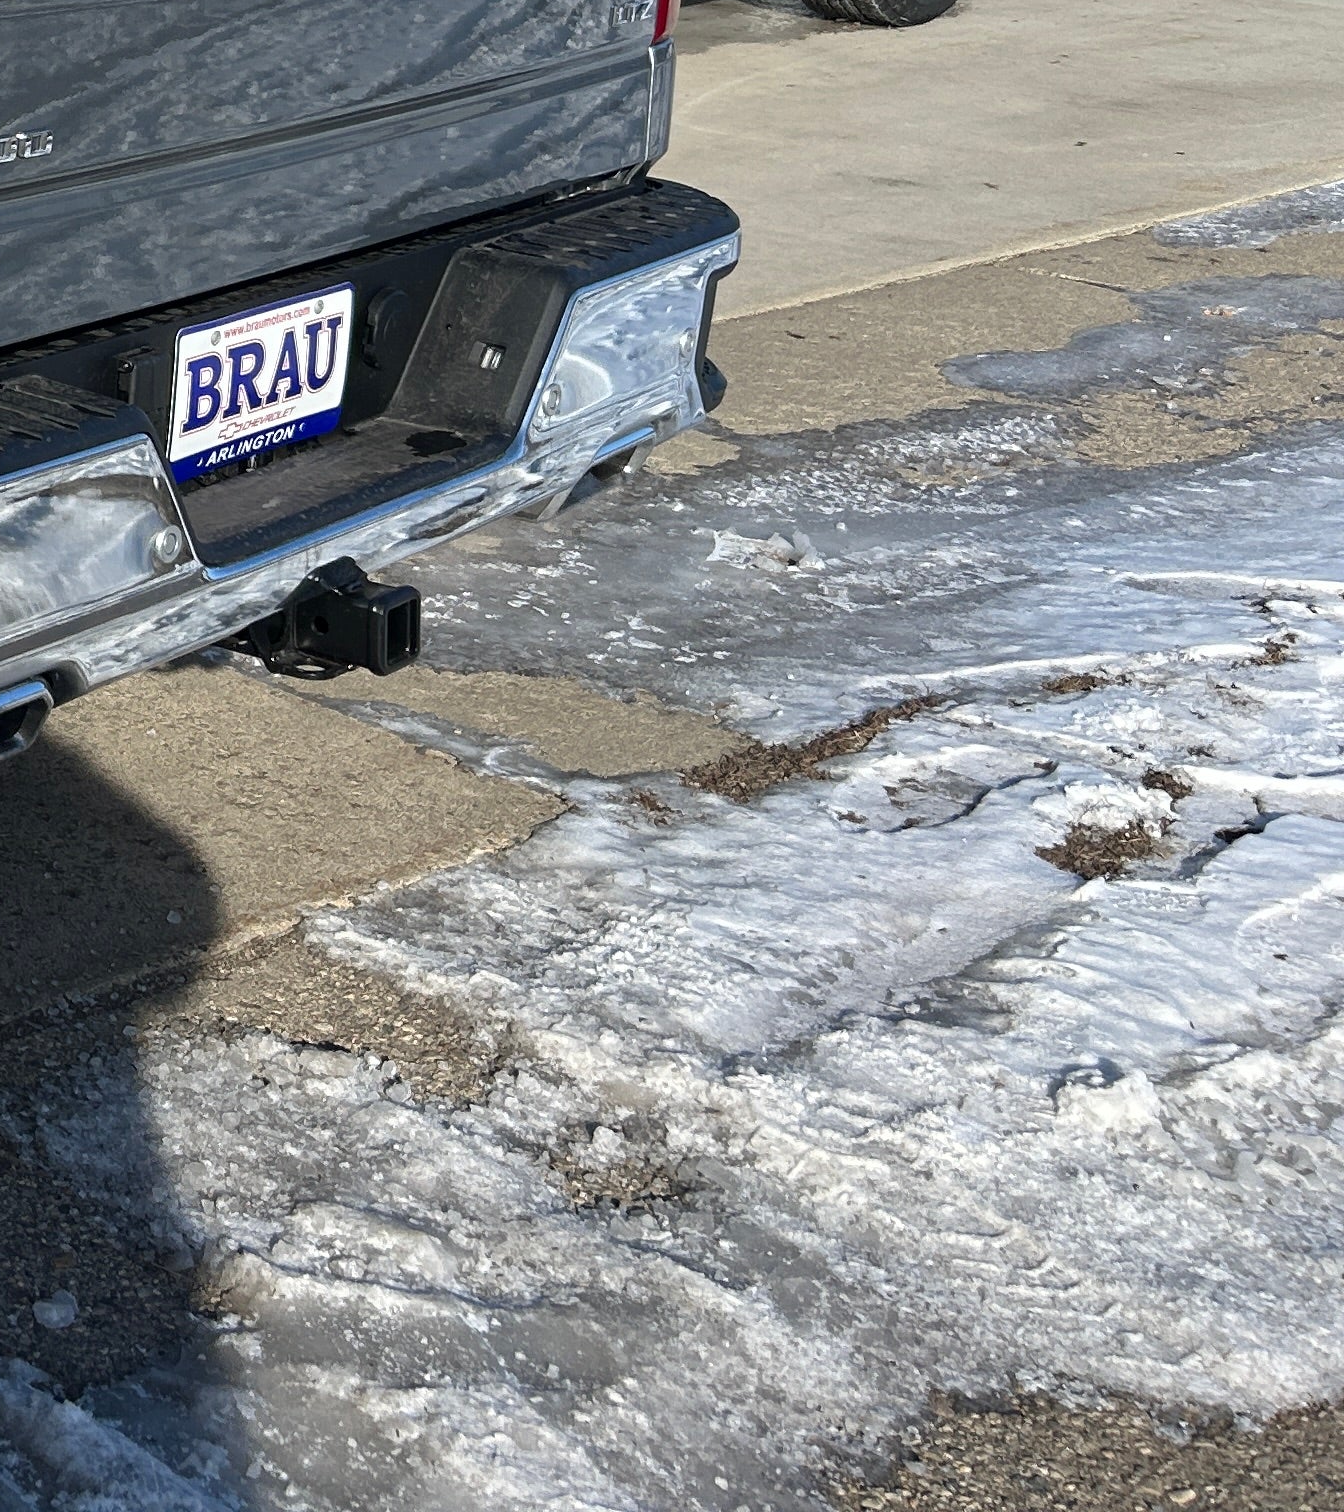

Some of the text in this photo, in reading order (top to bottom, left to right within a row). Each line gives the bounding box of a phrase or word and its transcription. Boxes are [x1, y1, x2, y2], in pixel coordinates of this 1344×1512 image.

[223, 306, 311, 339] www.braumotors.com
[180, 313, 343, 436] BRAU
[240, 406, 296, 431] CHEVROLET
[204, 424, 296, 467] ARLINGTON
